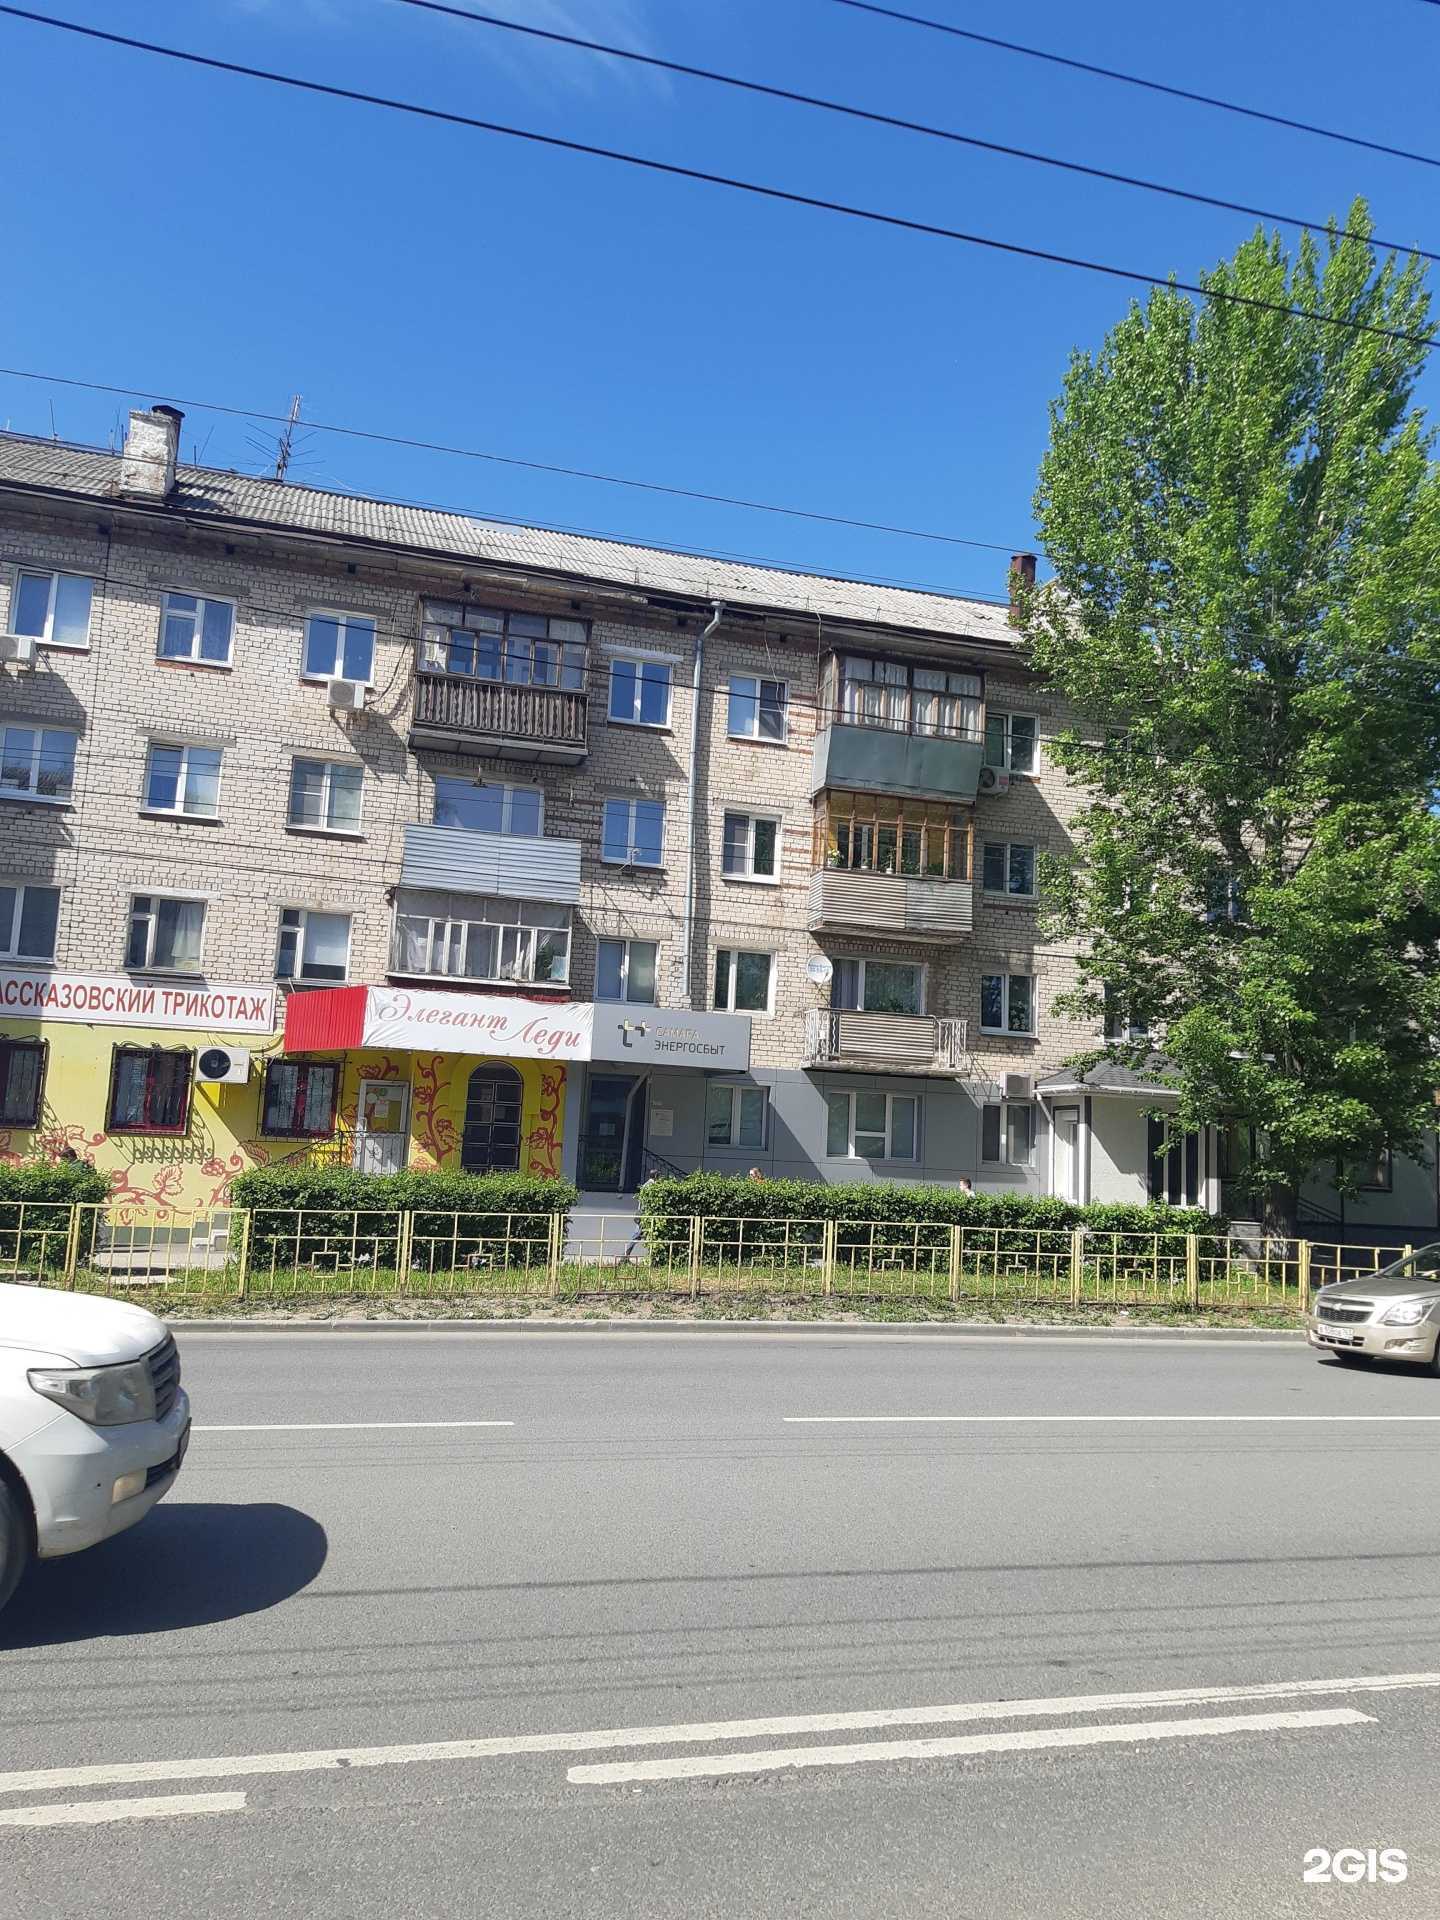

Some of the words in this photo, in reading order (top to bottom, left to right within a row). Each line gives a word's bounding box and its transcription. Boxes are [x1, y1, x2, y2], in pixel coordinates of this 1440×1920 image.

[0, 980, 155, 1014] ССКАЗОВСКИЙ
[161, 991, 267, 1021] ТРИКОТАЖ
[378, 993, 508, 1031] Элегант
[489, 1016, 583, 1055] Леди
[654, 1040, 726, 1056] ЭНЕРГОСБЫТ
